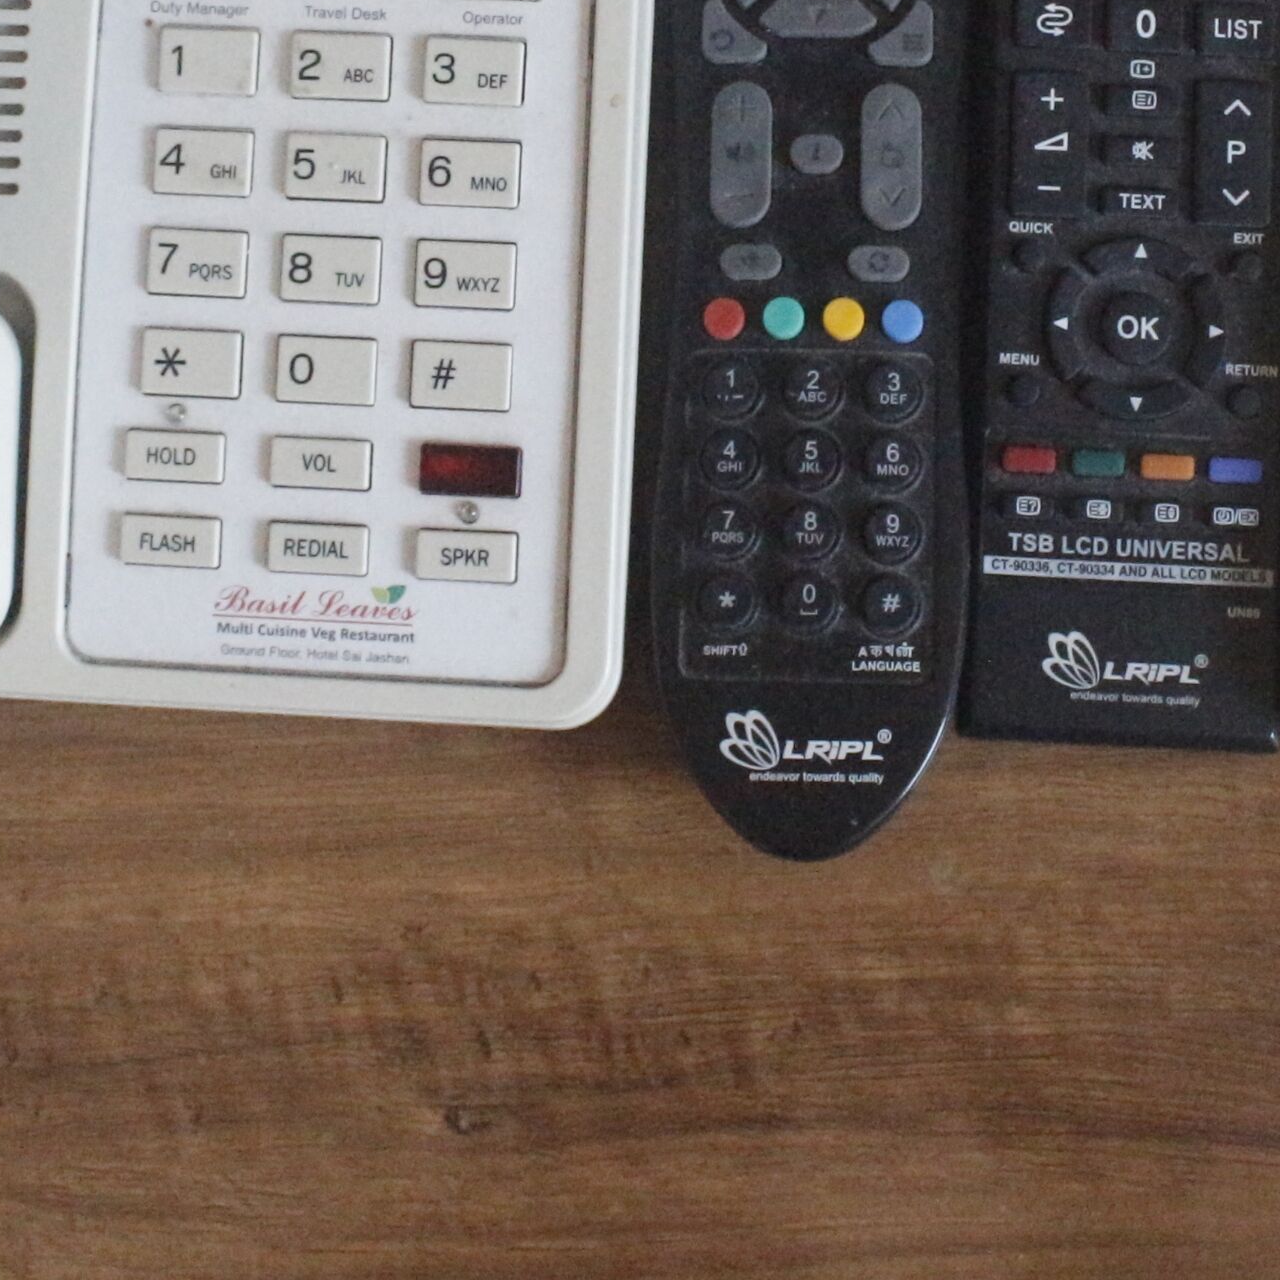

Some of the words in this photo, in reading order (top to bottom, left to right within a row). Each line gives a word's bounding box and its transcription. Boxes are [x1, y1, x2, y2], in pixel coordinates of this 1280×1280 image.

[150, 1, 183, 16] Duty
[187, 3, 248, 17] Manager
[305, 6, 346, 19] Travel
[352, 8, 386, 21] Desk
[462, 13, 523, 26] Operator
[1136, 10, 1157, 38] 0
[1214, 18, 1262, 40] LIST
[171, 46, 184, 76] 1
[298, 50, 321, 80] 2
[344, 68, 374, 83] ABC
[432, 53, 455, 84] 3
[477, 74, 507, 89] DEF
[1227, 140, 1246, 164] P
[160, 144, 185, 175] 4
[210, 164, 237, 179] GHI
[293, 149, 315, 180] 5
[340, 170, 366, 185] JKL
[428, 156, 451, 187] 6
[470, 176, 507, 191] MNO
[1119, 193, 1166, 210] TEXT
[1009, 221, 1053, 235] QUICK
[1233, 232, 1265, 245] EXIT
[158, 243, 179, 274] 7
[189, 264, 233, 280] PQRS
[289, 252, 313, 283] 8
[335, 272, 365, 287] TUV
[423, 257, 447, 289] 9
[456, 277, 500, 293] WXYZ
[1117, 316, 1160, 340] OK
[289, 353, 314, 384] 0
[999, 353, 1040, 366] MENU
[431, 358, 456, 389] #
[726, 370, 735, 387] 1
[1225, 363, 1278, 377] RETURN
[807, 371, 820, 389] 2
[888, 373, 901, 391] 3
[797, 391, 827, 403] ABC
[879, 393, 908, 405] DEF
[146, 447, 196, 466] HOLD
[723, 441, 736, 458] 4
[805, 441, 818, 459] 5
[886, 443, 900, 462] 6
[302, 454, 336, 473] VOL
[717, 462, 742, 473] GHI
[799, 462, 820, 473] JKL
[876, 464, 909, 476] MNO
[722, 511, 735, 528] 7
[805, 512, 817, 530] 8
[886, 514, 900, 533] 9
[139, 531, 195, 552] FLASH
[711, 532, 744, 544] PQRS
[797, 532, 824, 544] TUV
[875, 535, 910, 548] WXYZ
[283, 538, 349, 559] REDIAL
[1008, 532, 1054, 553] TSB
[1061, 536, 1108, 555] LCD
[1116, 538, 1249, 563] UNIVERSAL
[440, 548, 489, 567] SPKR
[1057, 562, 1115, 576] CT-90334
[1119, 565, 1147, 578] AND
[1151, 566, 1176, 580] ALL
[1180, 568, 1207, 581] LCD
[214, 585, 307, 616] Basil
[313, 590, 417, 621] Leaves
[802, 585, 815, 604] 0
[882, 594, 901, 612] #
[217, 622, 252, 635] Multi
[258, 624, 307, 638] Cuisine
[312, 628, 336, 641] Veg
[341, 628, 415, 643] Restaurant
[221, 644, 265, 656] Ground
[306, 649, 337, 661] Hotel
[342, 650, 362, 662] Sai
[366, 651, 409, 664] Jashan
[703, 645, 737, 656] SHIFT
[852, 661, 921, 672] LANGUAGE
[1070, 691, 1118, 703] endeavor
[1122, 692, 1163, 704] towards
[1166, 694, 1200, 707] quality
[749, 772, 800, 783] endeavor
[803, 772, 845, 783] towards
[849, 773, 884, 785] quality
